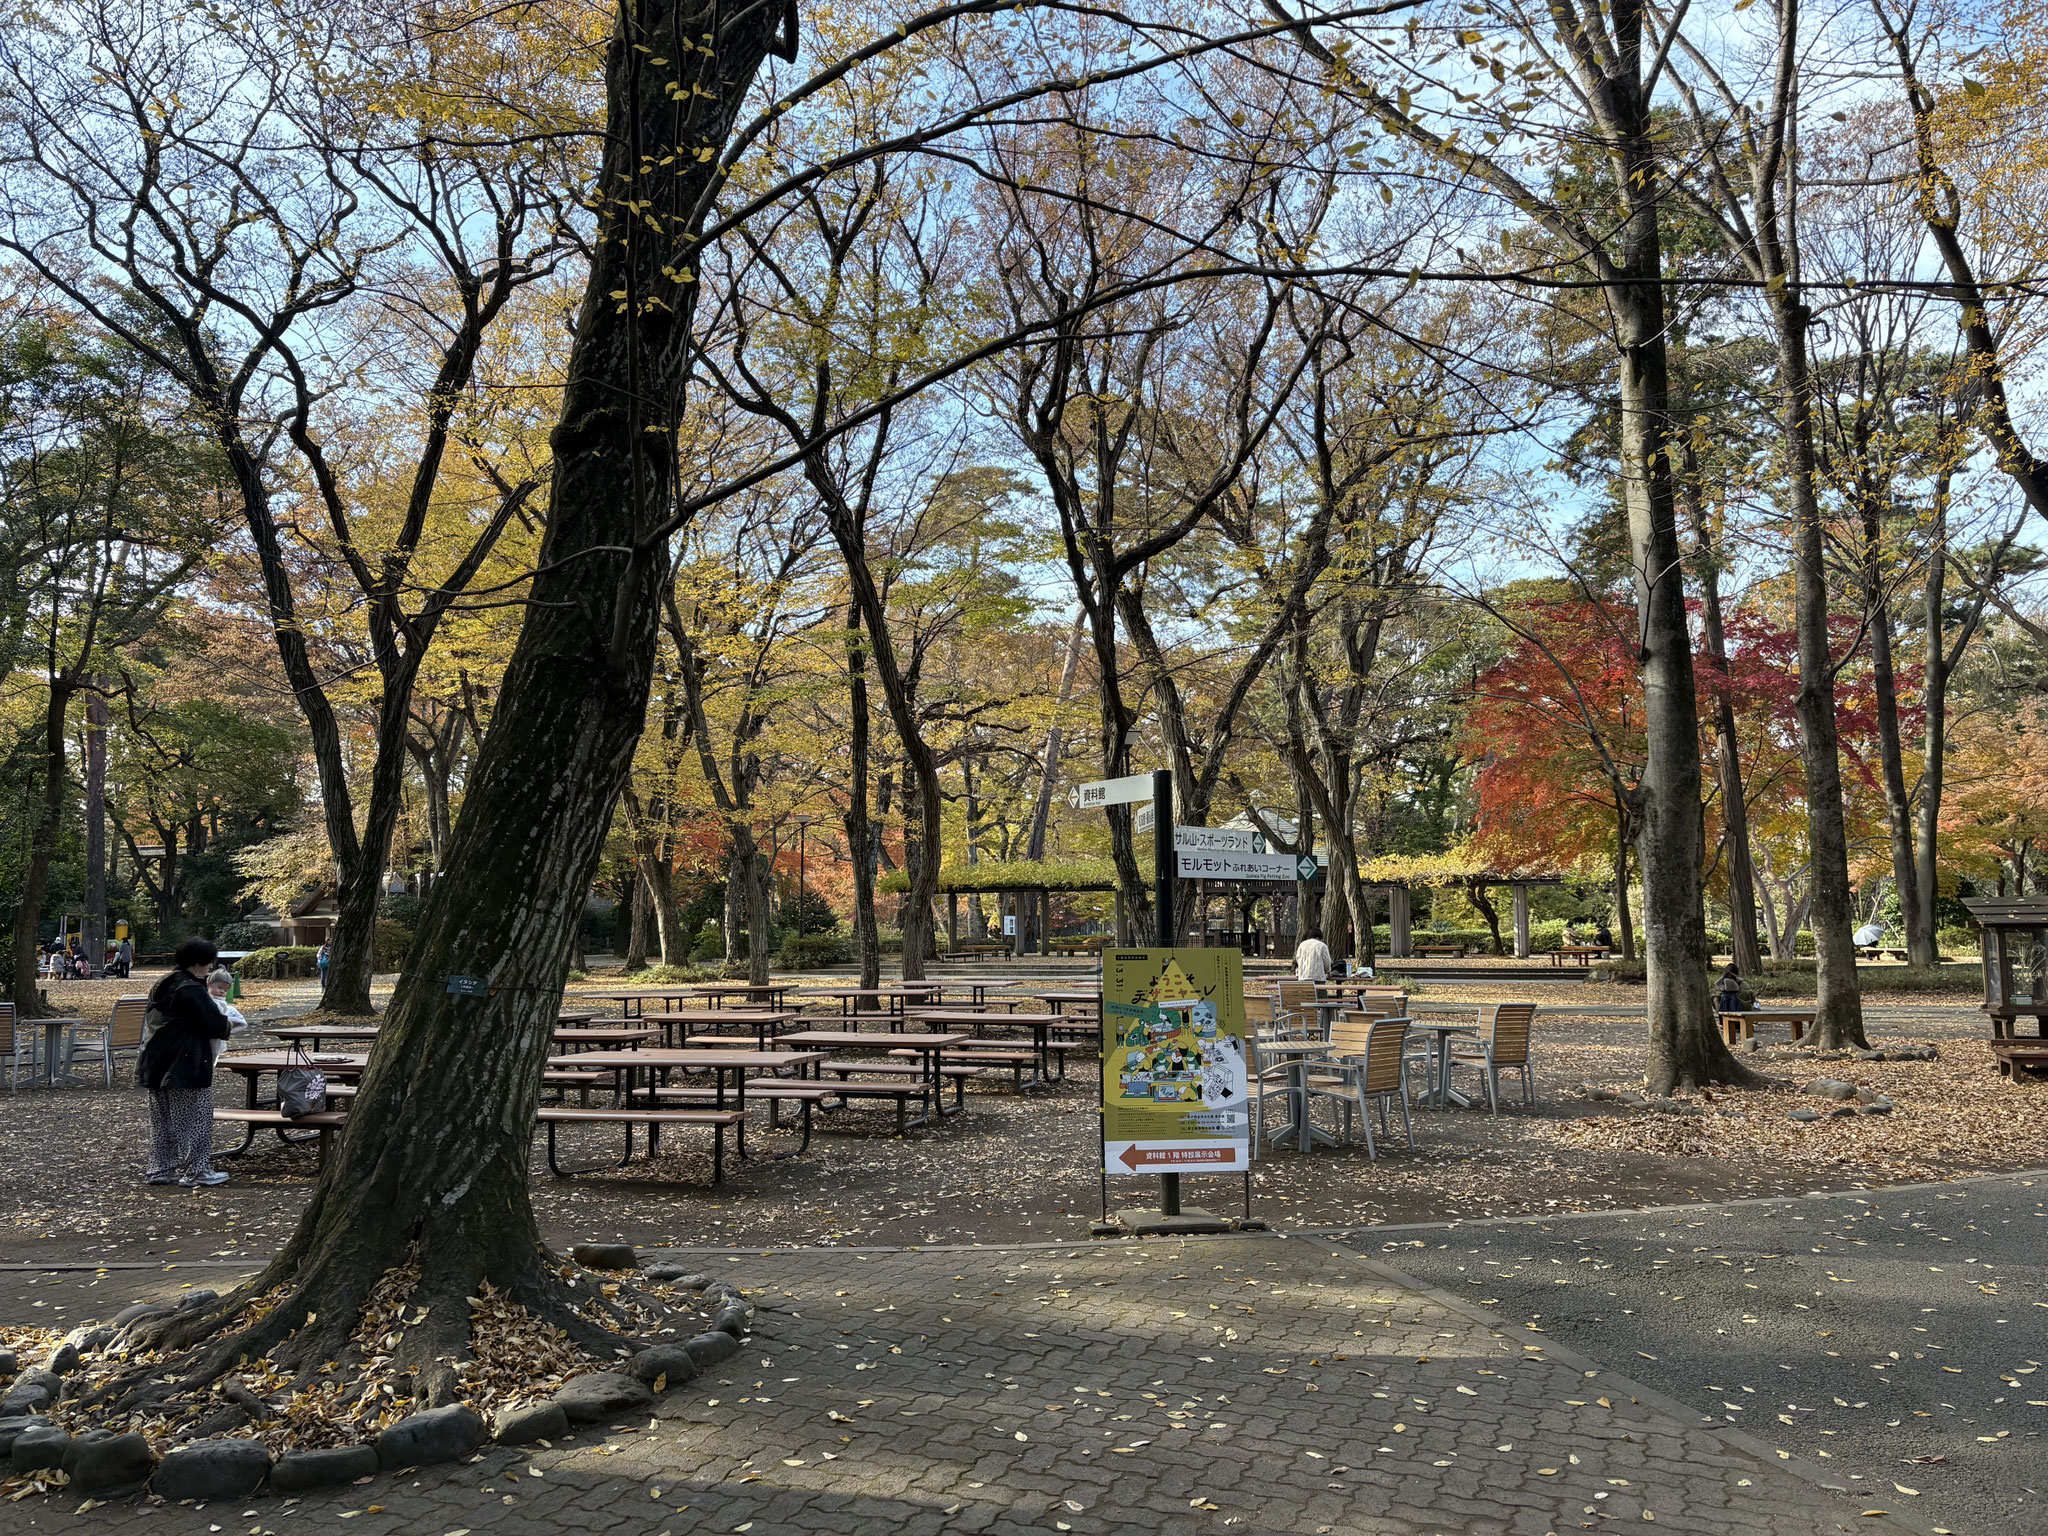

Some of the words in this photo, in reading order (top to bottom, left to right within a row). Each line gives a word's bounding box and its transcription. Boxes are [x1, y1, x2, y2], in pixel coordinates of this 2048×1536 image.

[1084, 787, 1106, 802] 資料館
[1149, 973, 1196, 987] ようこそ
